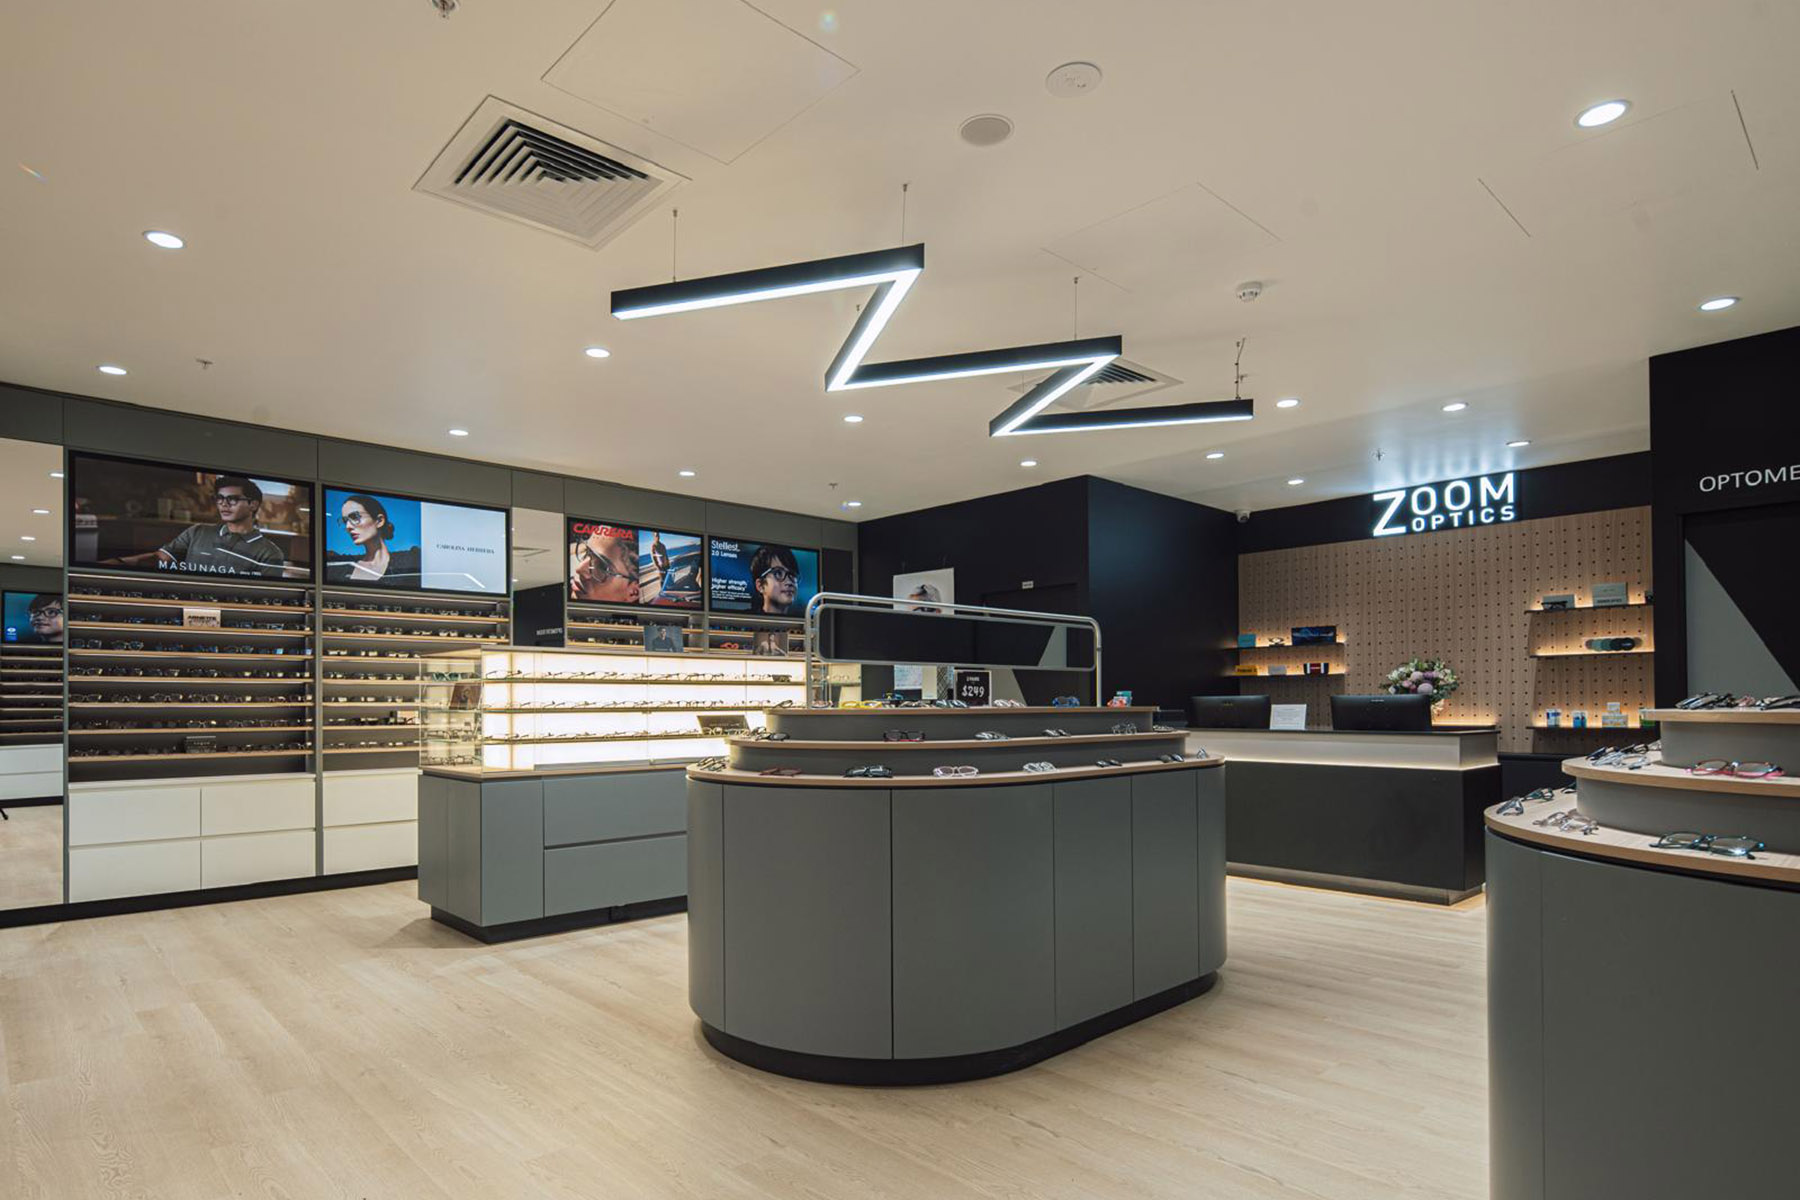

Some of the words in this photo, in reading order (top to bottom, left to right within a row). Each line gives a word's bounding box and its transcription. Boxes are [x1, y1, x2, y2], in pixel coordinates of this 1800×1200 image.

[1699, 465, 1800, 492] OPTOME
[1373, 472, 1515, 537] ZOOM
[1412, 505, 1515, 532] OPTICS
[573, 522, 633, 538] CARRERA
[158, 560, 236, 574] MASUNAGA
[962, 685, 984, 697] $249
